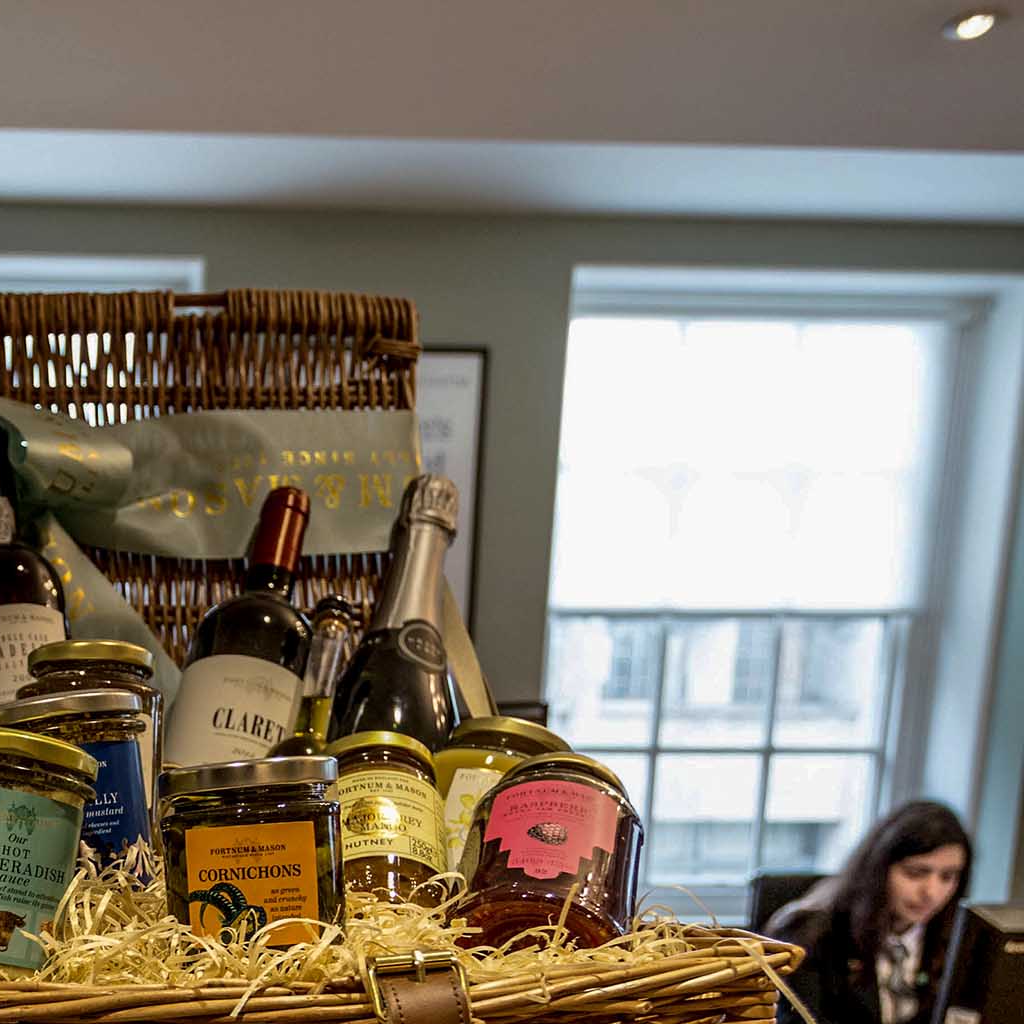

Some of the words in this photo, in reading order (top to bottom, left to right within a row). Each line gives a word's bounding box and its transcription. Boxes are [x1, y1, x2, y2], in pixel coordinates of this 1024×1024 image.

[212, 707, 286, 743] CLARET
[338, 782, 383, 795] ORTNUM
[396, 784, 427, 798] MASON
[86, 805, 124, 818] mustard
[8, 833, 28, 845] Our
[345, 840, 393, 850] HUTNEY
[2, 845, 31, 859] HOT
[210, 847, 250, 856] FORTNUM
[257, 844, 286, 852] MASON
[198, 864, 302, 882] CORNICHONS
